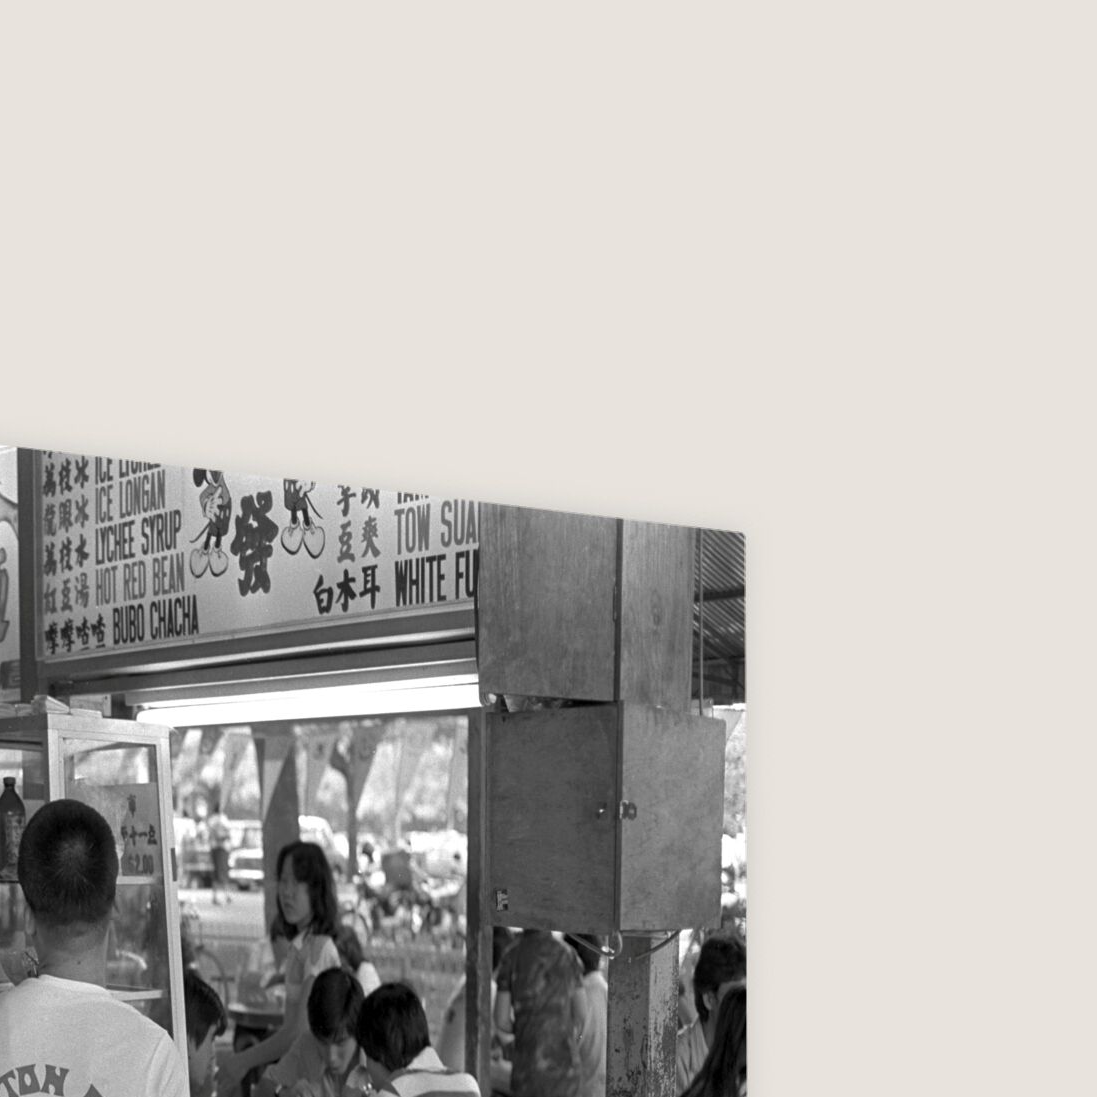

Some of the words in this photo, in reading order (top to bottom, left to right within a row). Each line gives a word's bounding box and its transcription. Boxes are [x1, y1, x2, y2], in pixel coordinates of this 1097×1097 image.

[95, 456, 113, 485] ICE
[95, 484, 113, 525] ICE
[119, 470, 166, 519] LONGAN
[95, 520, 135, 566] LYCHEE
[141, 509, 182, 555] SYRUP
[337, 515, 381, 563] 豆爽
[394, 503, 431, 555] TOW
[440, 499, 480, 548] SUA
[95, 565, 118, 606] HOT
[123, 560, 146, 602] RED
[153, 552, 186, 596] BEAN
[313, 564, 381, 615] 白木耳
[395, 554, 446, 607] WHITE
[112, 602, 144, 646] BUBO
[150, 594, 199, 639] CHACHA
